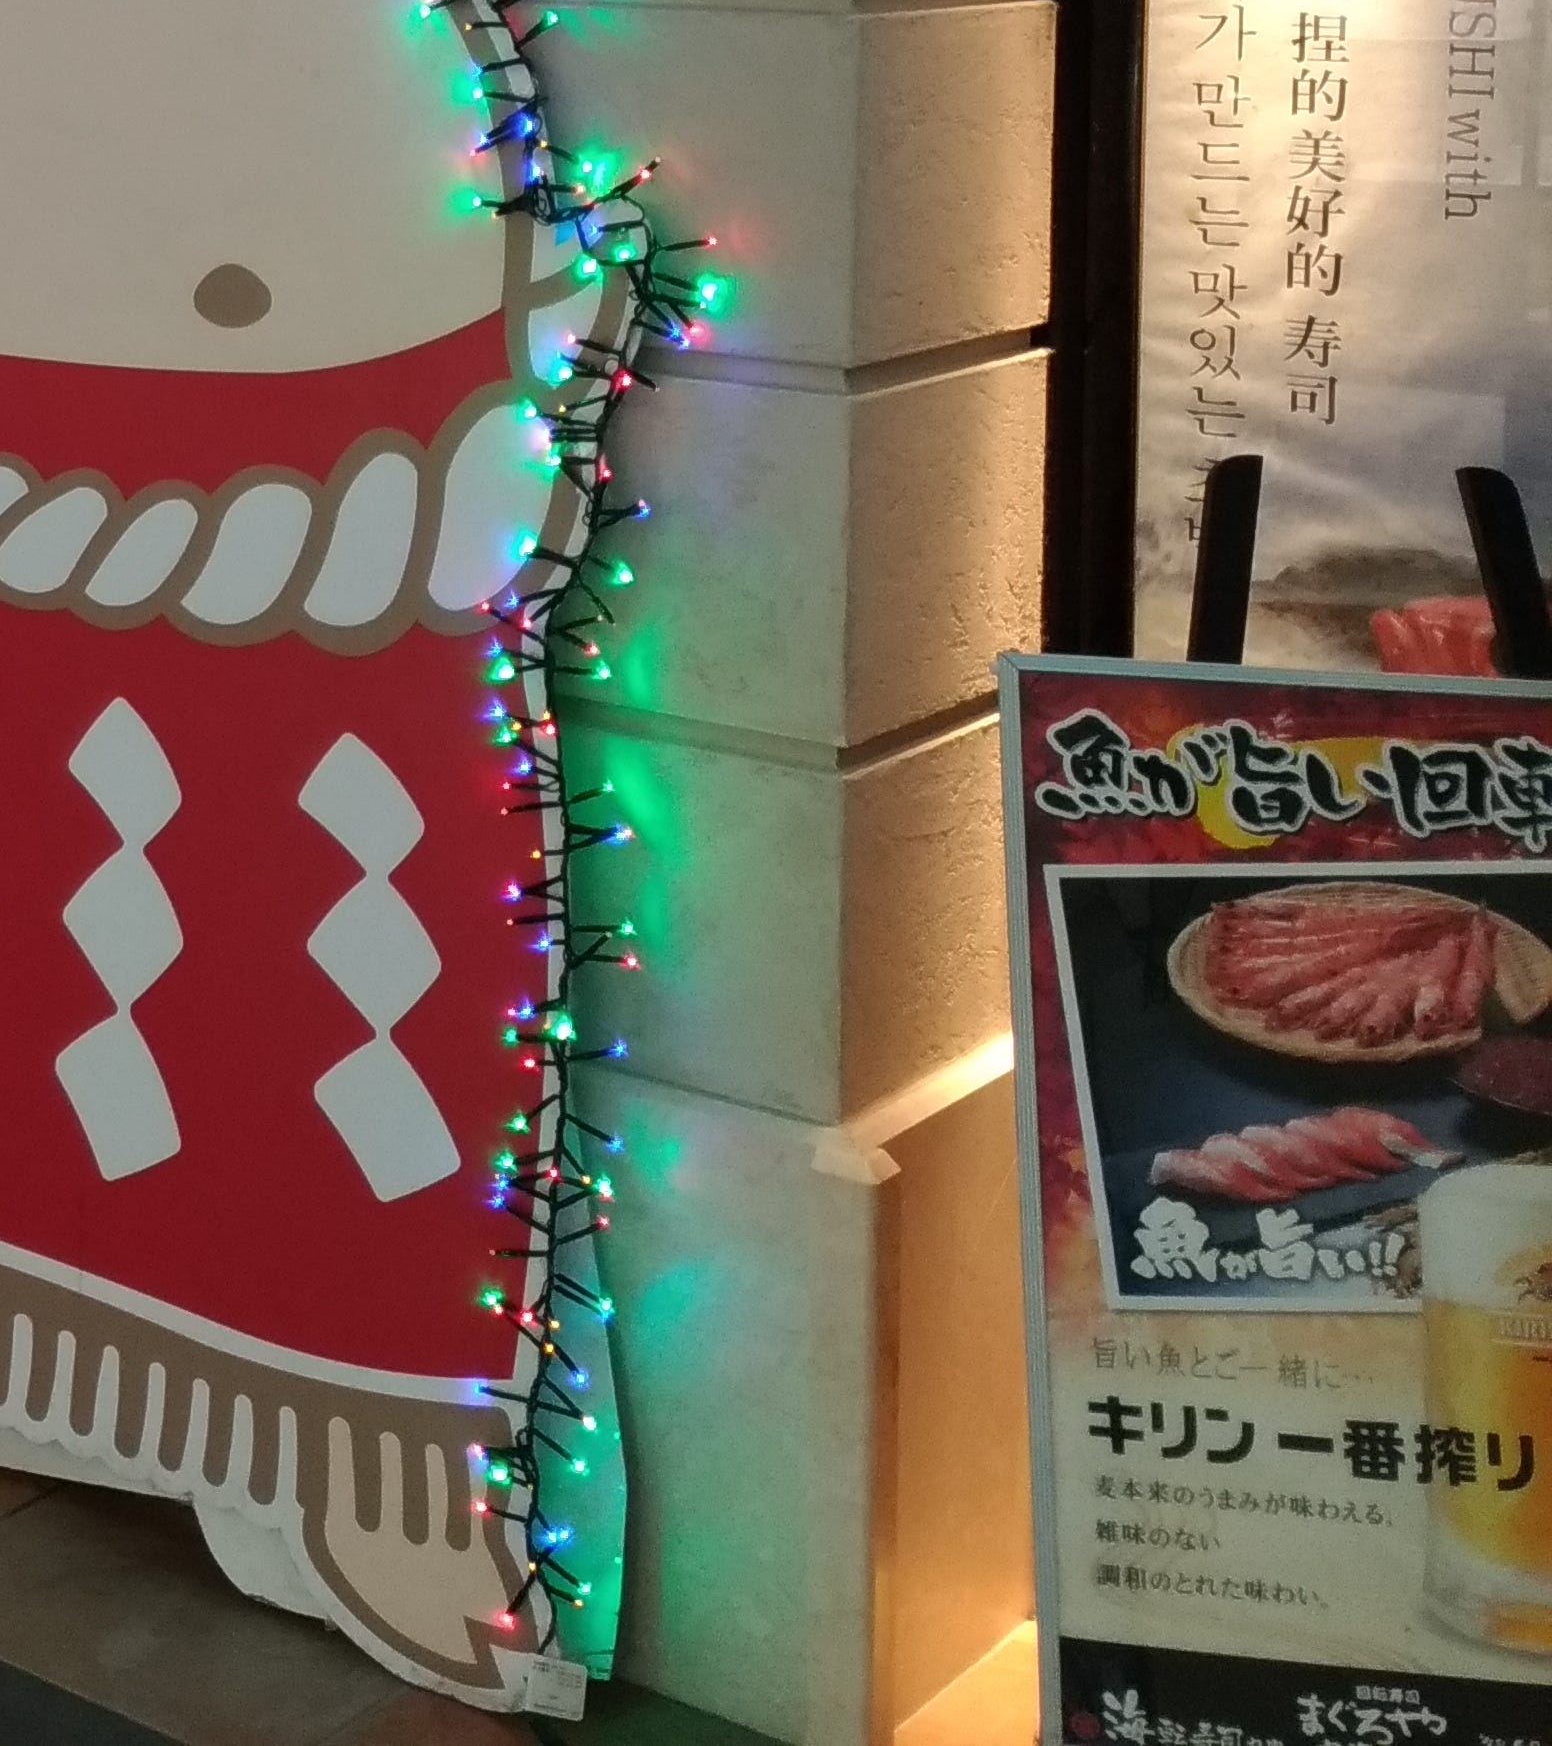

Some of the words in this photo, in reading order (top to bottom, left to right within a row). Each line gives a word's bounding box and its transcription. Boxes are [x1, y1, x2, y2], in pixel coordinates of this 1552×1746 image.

[1188, 75, 1252, 247] 만드는
[1444, 113, 1493, 222] with
[1185, 263, 1248, 438] 맛있는
[1095, 1474, 1393, 1527] 麦本来のうまみが味わえる。
[1095, 1517, 1221, 1552] 雑味のない
[1095, 1563, 1329, 1609] 調和のとれた味わい。
[1296, 1692, 1448, 1745] まぐろや
